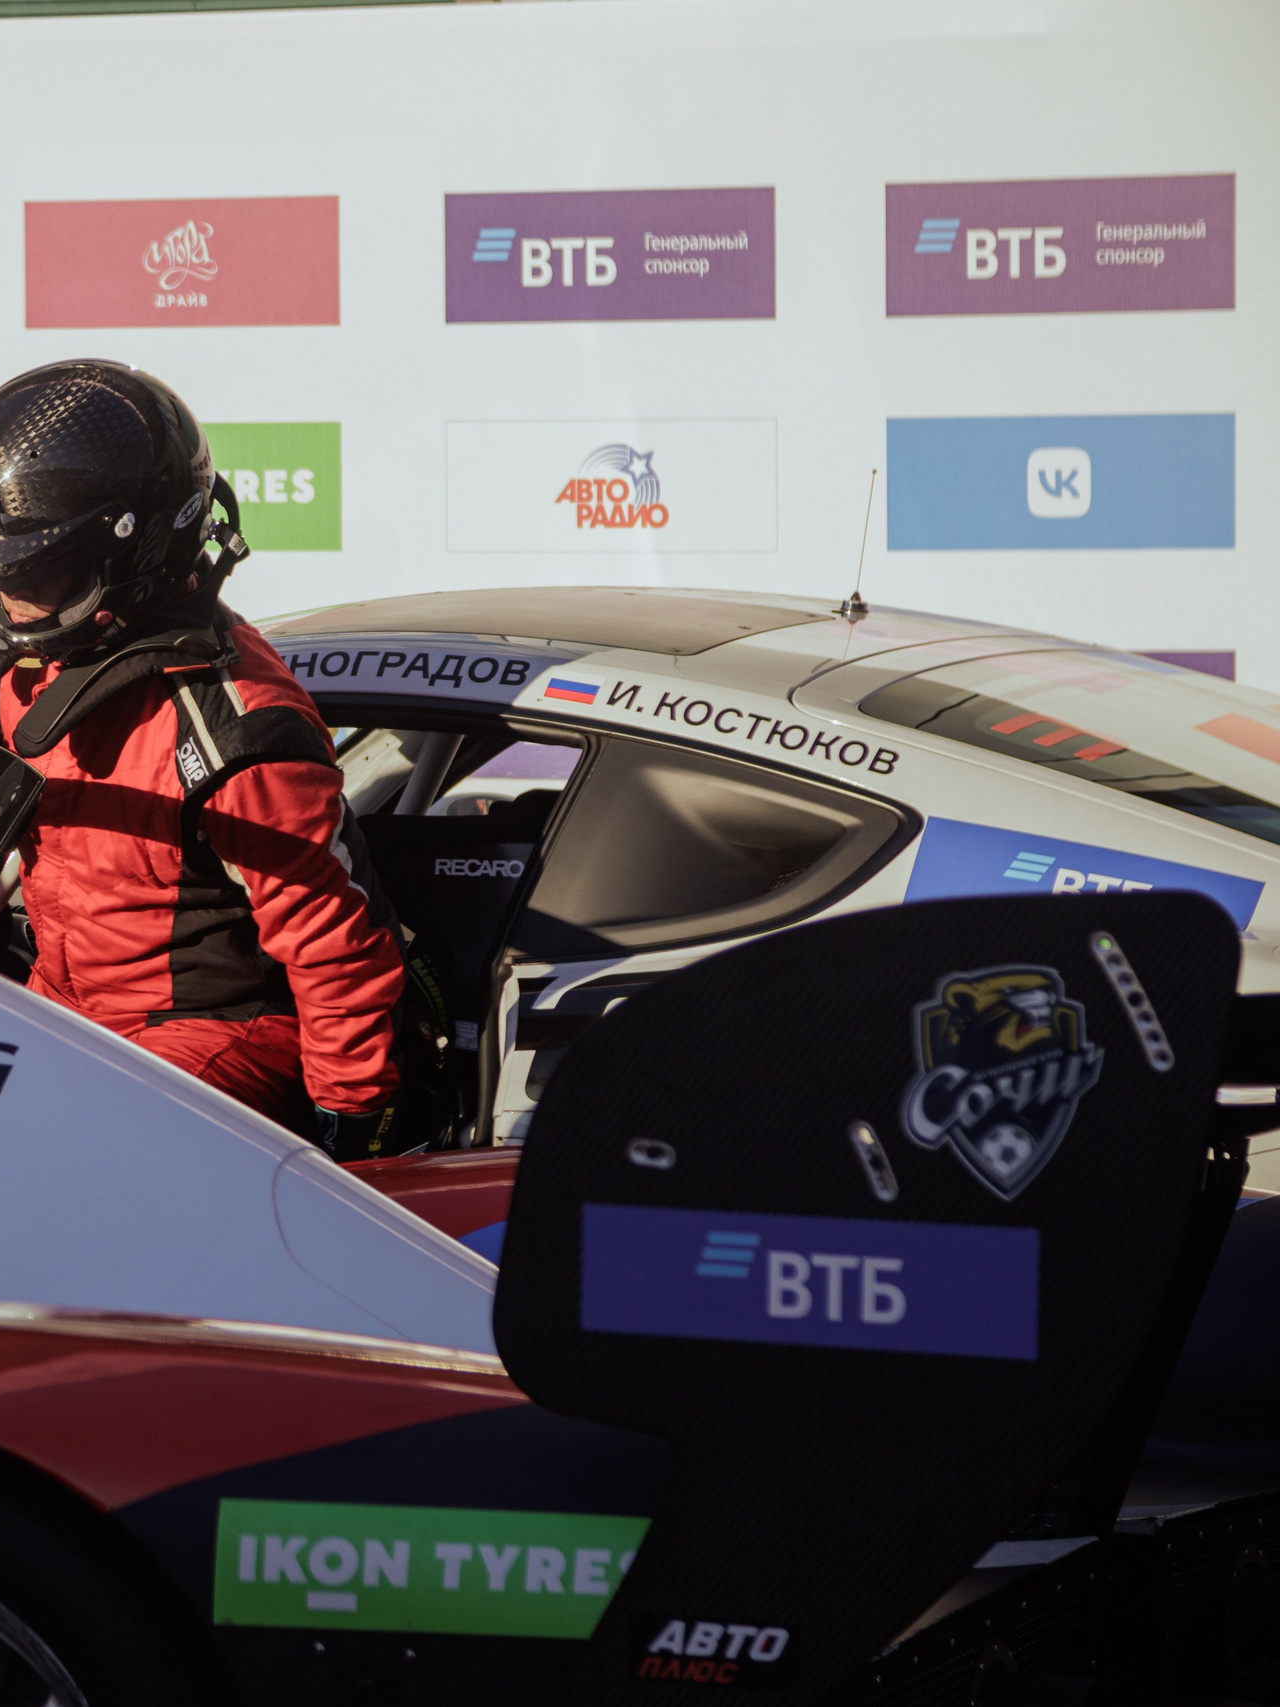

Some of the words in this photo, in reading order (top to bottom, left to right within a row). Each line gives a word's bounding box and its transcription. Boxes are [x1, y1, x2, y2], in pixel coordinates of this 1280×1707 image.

[644, 230, 749, 254] Генеральный
[1096, 218, 1207, 245] Генеральный
[521, 236, 617, 288] ВТБ
[966, 226, 1067, 279] ВТБ
[1096, 246, 1165, 268] спонсор
[644, 257, 710, 278] спонсор
[155, 290, 208, 308] ДРАЙВ
[220, 469, 316, 504] RES
[554, 478, 630, 504] АВТО
[576, 503, 670, 529] РАДИО
[283, 651, 531, 688] НОГРАДОВ
[653, 692, 900, 775] КОСТЮКОВ
[181, 743, 205, 781] OMP
[434, 859, 525, 878] RECARO
[1051, 867, 1153, 894] ВТ
[767, 1250, 907, 1325] ВТБ
[239, 1533, 411, 1589] IKON
[647, 1618, 790, 1663] АВТО
[637, 1655, 739, 1684] ПЛЮС
